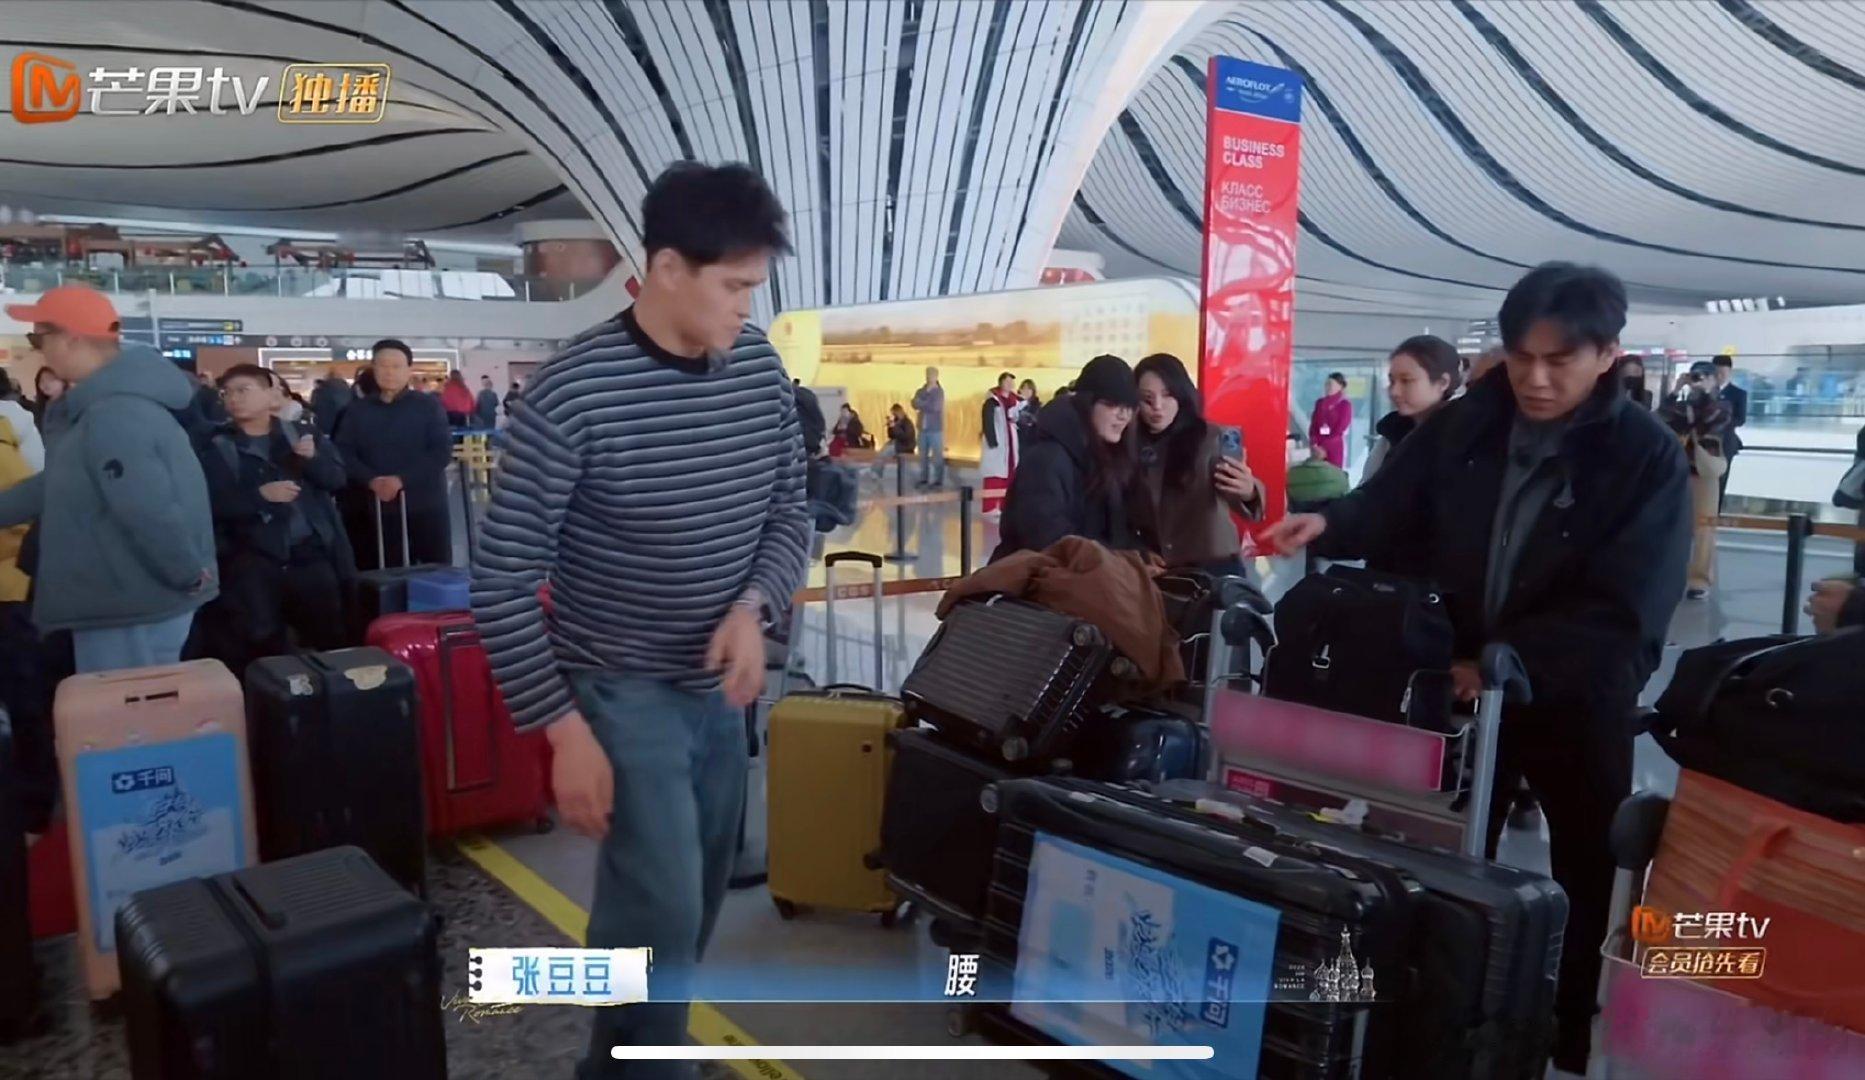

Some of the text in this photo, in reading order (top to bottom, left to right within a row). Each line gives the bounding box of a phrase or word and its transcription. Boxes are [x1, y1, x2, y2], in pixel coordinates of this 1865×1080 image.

[1223, 136, 1285, 157] BUSINESS
[1222, 151, 1264, 169] CLASS
[1220, 180, 1264, 199] КЛАСС
[1220, 194, 1272, 214] БИЗНЕС
